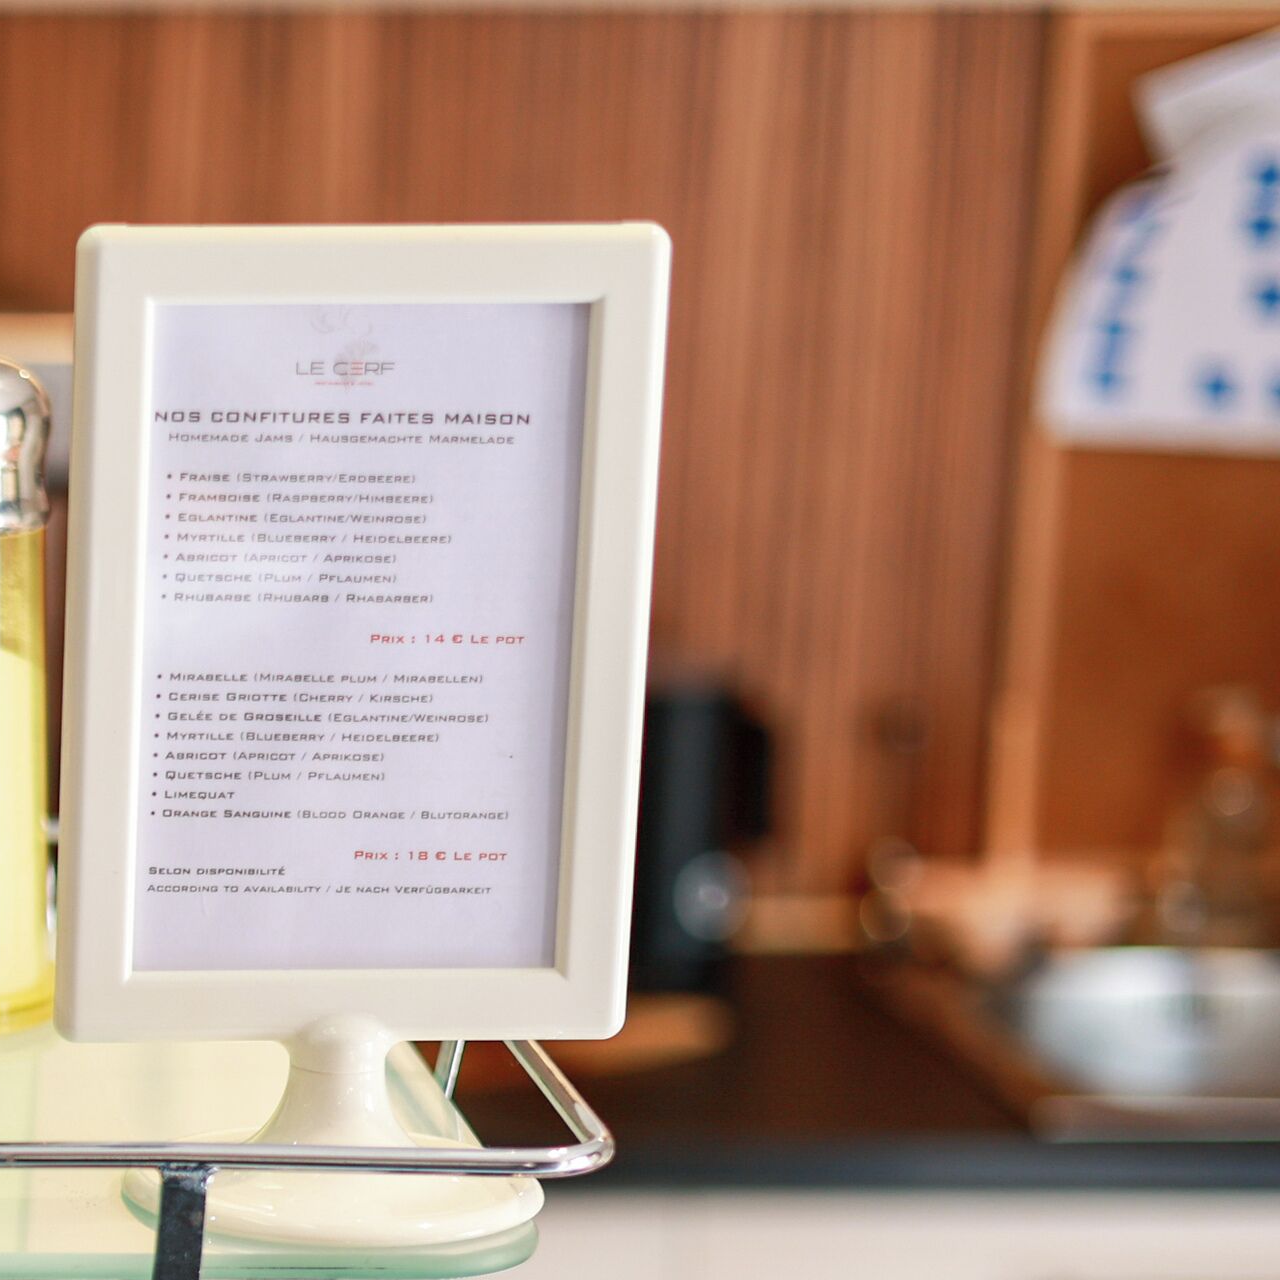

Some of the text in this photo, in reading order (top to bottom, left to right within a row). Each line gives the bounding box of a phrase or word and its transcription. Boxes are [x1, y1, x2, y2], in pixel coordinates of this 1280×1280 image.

[296, 361, 395, 376] LE CERF
[155, 411, 531, 425] NOS CONFITURES FAITES MAISON
[426, 634, 445, 644] 14
[451, 634, 463, 644] €
[408, 851, 428, 861] 18
[435, 851, 447, 861] €
